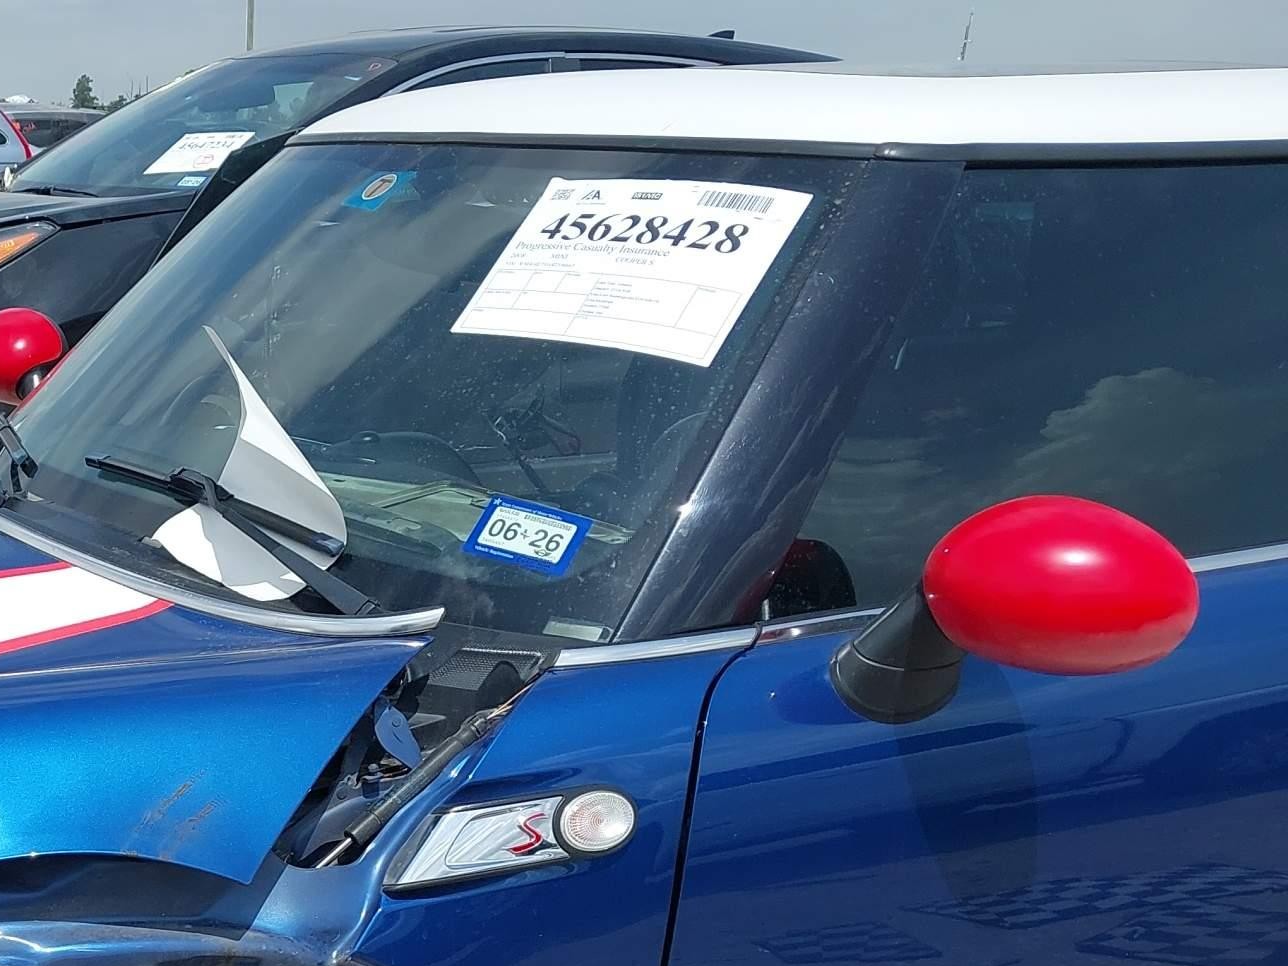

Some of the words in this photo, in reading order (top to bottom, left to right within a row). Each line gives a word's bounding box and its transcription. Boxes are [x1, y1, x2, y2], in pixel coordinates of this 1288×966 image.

[515, 241, 572, 255] Progressive
[573, 243, 617, 256] Casualty
[619, 244, 671, 257] Insurance
[540, 213, 749, 254] 45628428
[488, 518, 522, 541] 06
[528, 529, 564, 552] 26
